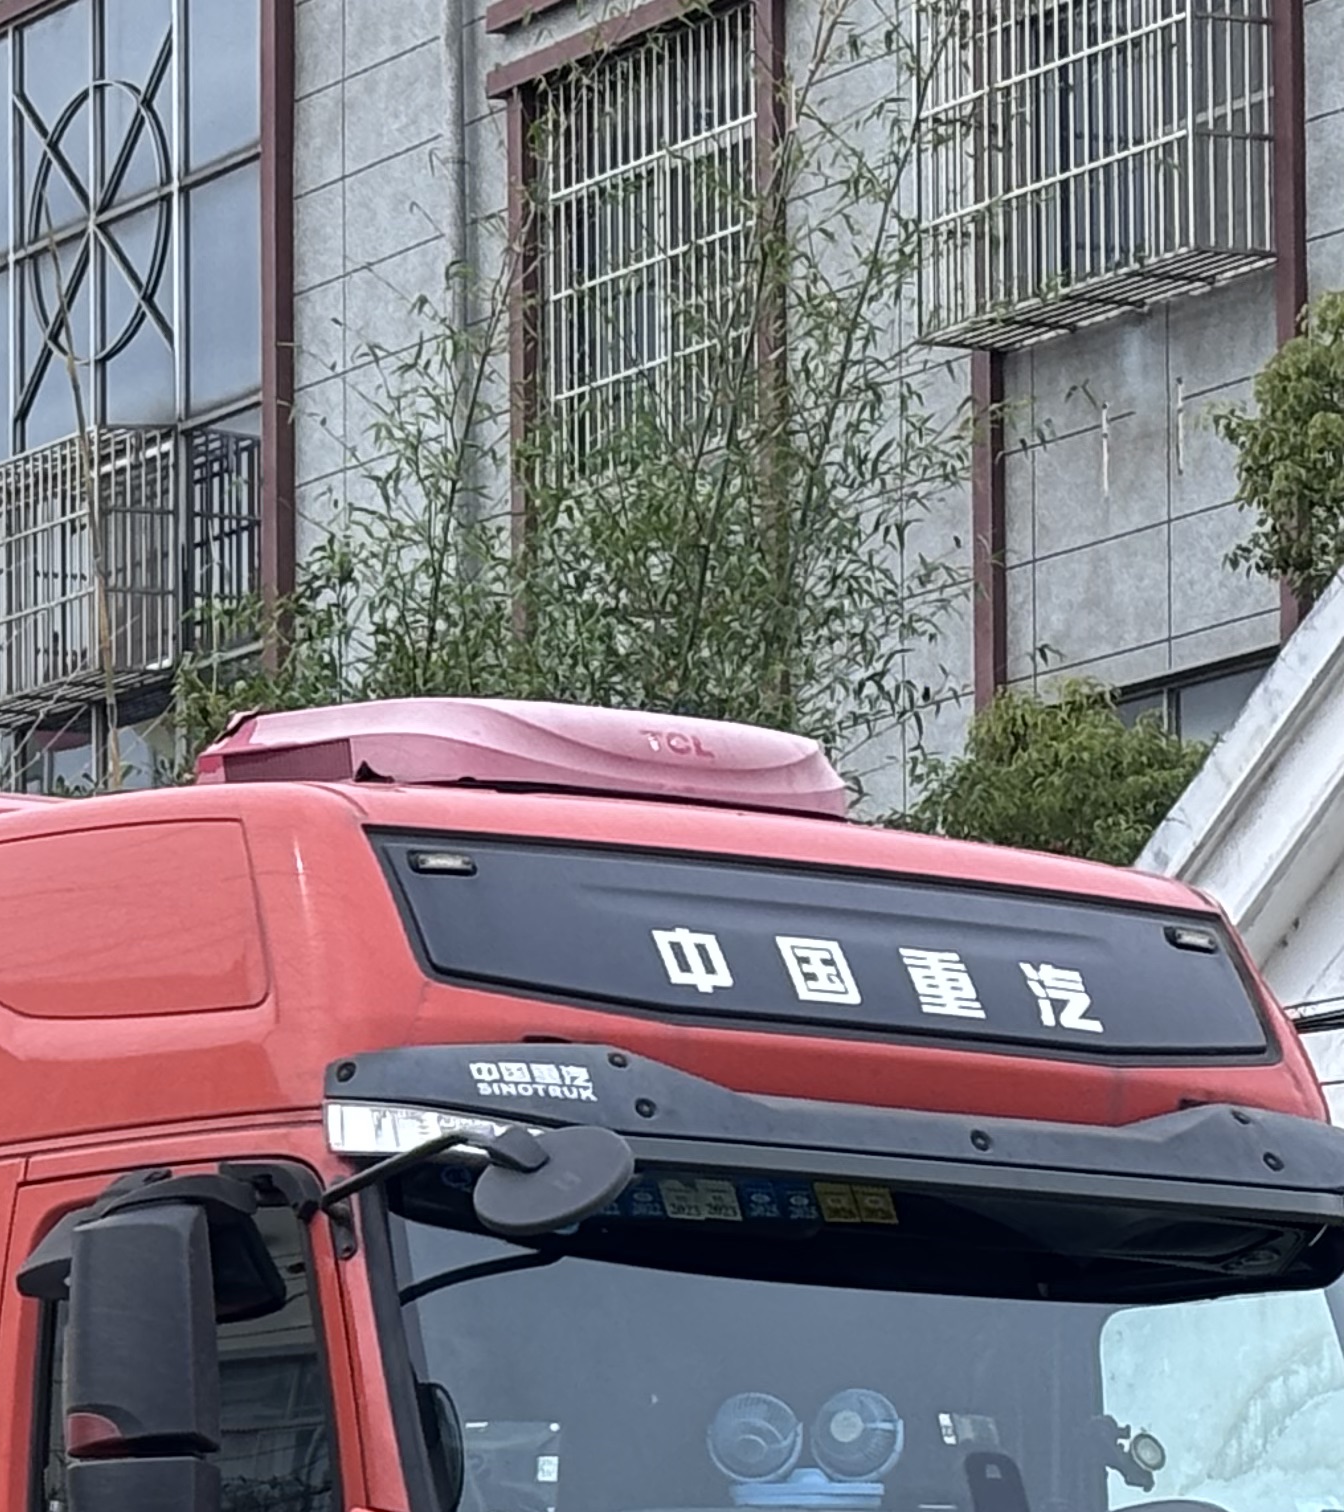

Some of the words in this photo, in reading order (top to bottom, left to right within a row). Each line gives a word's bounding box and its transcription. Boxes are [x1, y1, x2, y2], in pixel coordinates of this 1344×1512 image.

[639, 729, 715, 759] TCL
[652, 927, 1104, 1033] 中国重汽
[469, 1062, 592, 1087] 中国重汽
[476, 1082, 598, 1102] SINOTRUK
